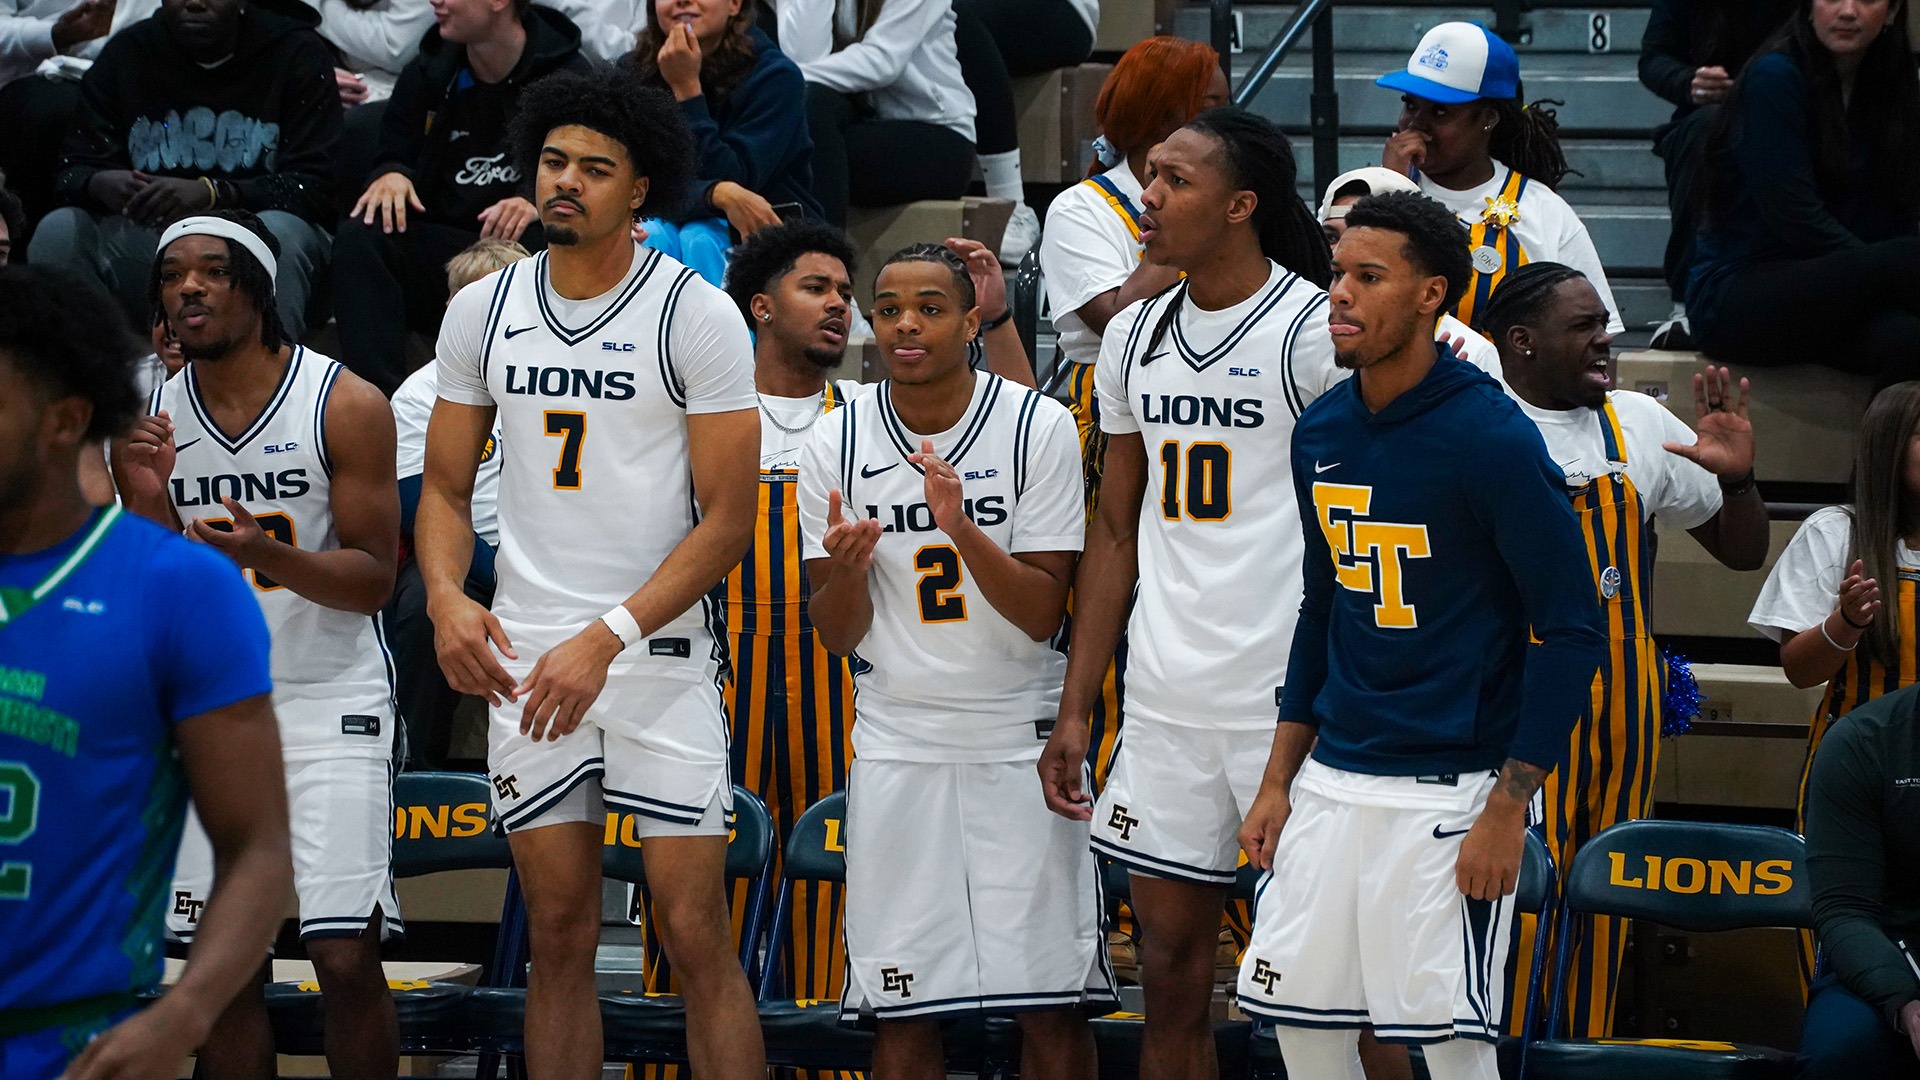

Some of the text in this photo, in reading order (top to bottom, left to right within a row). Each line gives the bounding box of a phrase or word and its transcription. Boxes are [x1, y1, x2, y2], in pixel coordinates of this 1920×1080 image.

[1592, 14, 1606, 50] 8
[505, 364, 636, 401] LIONS
[1141, 393, 1265, 429] LIONS
[543, 409, 587, 490] 7
[170, 468, 310, 506] LIONS
[1160, 439, 1233, 522] 10
[1312, 481, 1432, 629] ET
[913, 543, 968, 624] 2
[1710, 709, 1718, 721] 9
[492, 774, 521, 801] ET
[1107, 803, 1140, 842] ET
[1608, 852, 1793, 895] LIONS
[173, 890, 205, 924] ET
[880, 967, 914, 998] ET
[1251, 957, 1282, 996] ET
